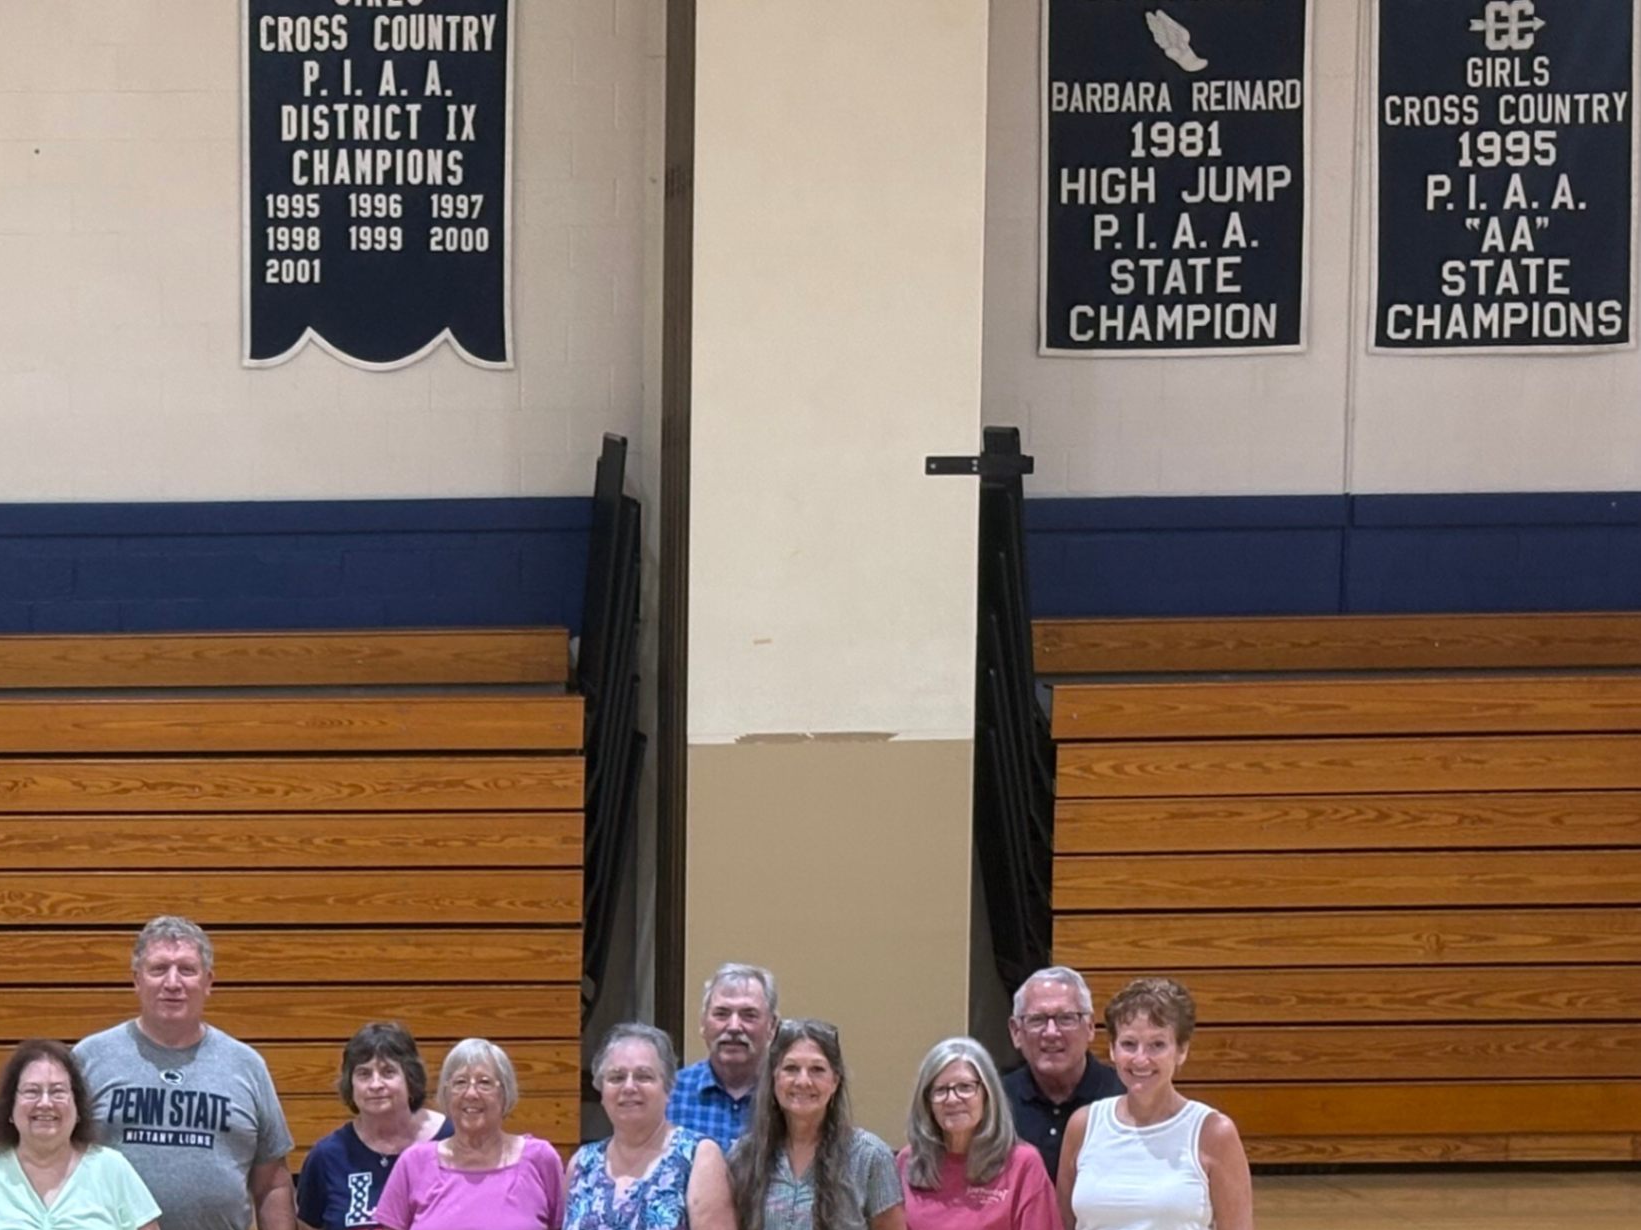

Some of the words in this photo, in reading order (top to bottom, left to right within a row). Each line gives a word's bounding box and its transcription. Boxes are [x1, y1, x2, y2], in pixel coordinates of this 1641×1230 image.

[259, 14, 348, 52] CROSS
[373, 13, 496, 52] COUNTRY
[1467, 56, 1550, 88] GIRLS
[1052, 81, 1172, 113] BARBARA
[1192, 79, 1301, 112] REINARD
[1385, 94, 1479, 126] CROSS
[1499, 91, 1628, 125] COUNTRY
[281, 103, 422, 141] DISTRICT
[446, 104, 477, 141] IX
[1131, 120, 1222, 158] 1981
[292, 148, 463, 186] CHAMPIONS
[1458, 130, 1557, 167] 1995
[1061, 167, 1155, 204] HIGH
[1181, 165, 1291, 203] JUMP
[266, 193, 320, 219] 1995
[349, 193, 402, 218] 1996
[430, 193, 484, 219] 1997
[266, 226, 320, 251] 1998
[349, 225, 403, 251] 1999
[430, 226, 489, 252] 2000
[265, 258, 321, 284] 2001
[1111, 256, 1242, 295] STATE
[1441, 257, 1570, 297] STATE
[1070, 303, 1277, 341] CHAMPION
[1386, 300, 1622, 340] CHAMPIONS
[107, 1087, 165, 1127] PENN
[169, 1088, 232, 1133] STATE
[125, 1129, 174, 1145] NITTANY
[178, 1132, 212, 1147] LIONS
